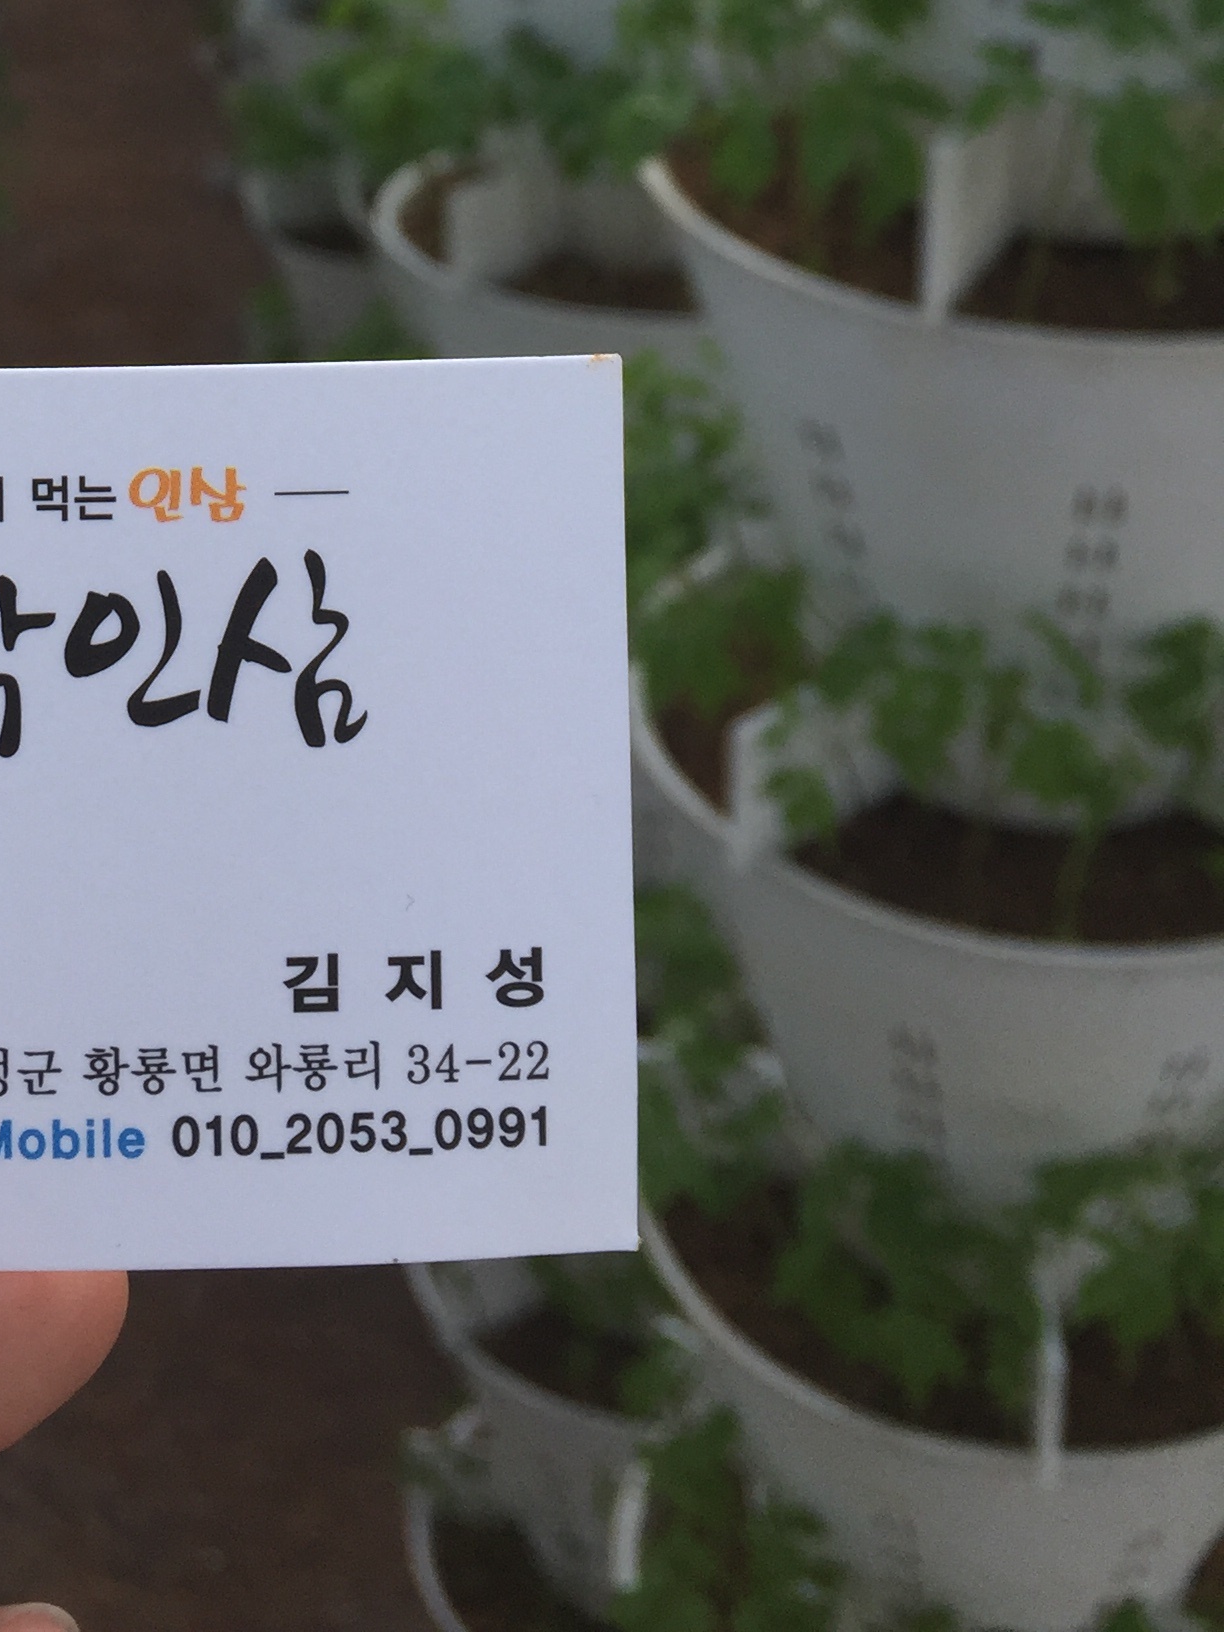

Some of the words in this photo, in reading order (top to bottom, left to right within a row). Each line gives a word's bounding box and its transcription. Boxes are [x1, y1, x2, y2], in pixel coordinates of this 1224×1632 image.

[30, 474, 118, 524] 먹는
[127, 465, 247, 524] 인삼
[81, 1043, 224, 1098] 황룡면
[243, 1039, 382, 1095] 와룡리
[405, 1039, 551, 1086] 34-22
[170, 1104, 548, 1162] 010_2053_0991
